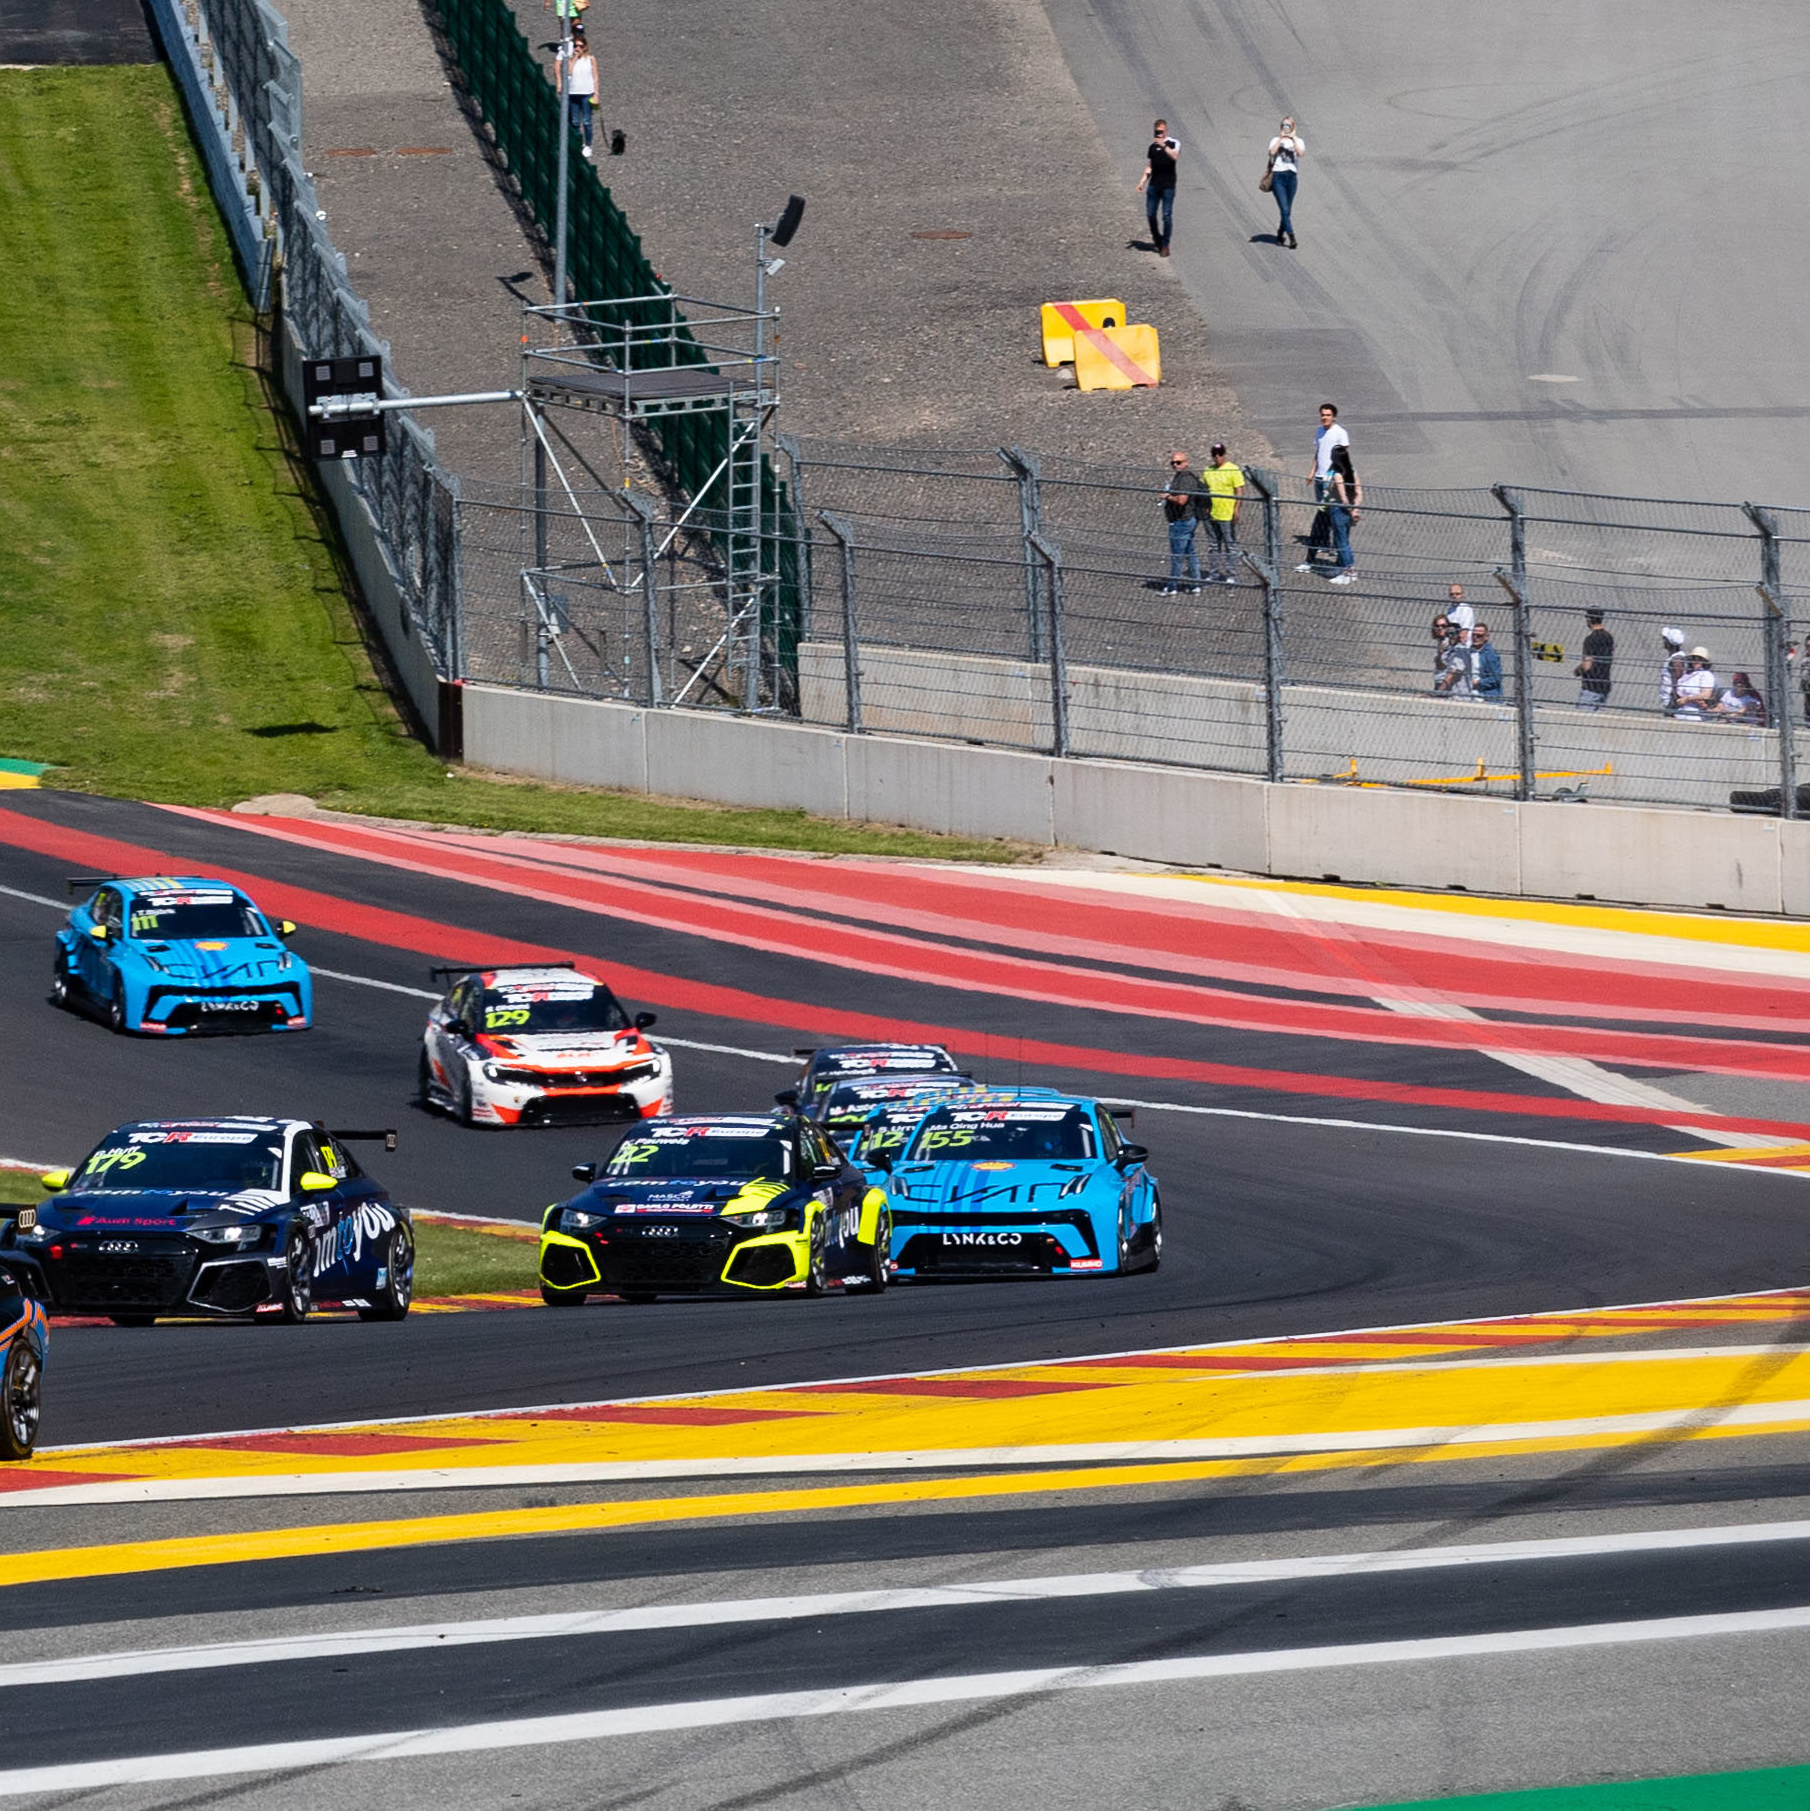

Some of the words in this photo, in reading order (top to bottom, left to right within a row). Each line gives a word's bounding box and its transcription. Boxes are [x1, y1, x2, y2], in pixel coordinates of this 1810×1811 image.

[131, 915, 159, 931] 111
[484, 1010, 531, 1028] 129
[886, 1113, 925, 1123] TC
[951, 1111, 1008, 1121] TCR
[129, 1132, 193, 1143] TCR
[650, 1127, 710, 1137] TCR
[921, 1130, 975, 1150] 155
[610, 1145, 660, 1164] 22
[85, 1152, 147, 1175] 179
[133, 1218, 176, 1226] Sport
[943, 1233, 1022, 1245] LYNK&CO
